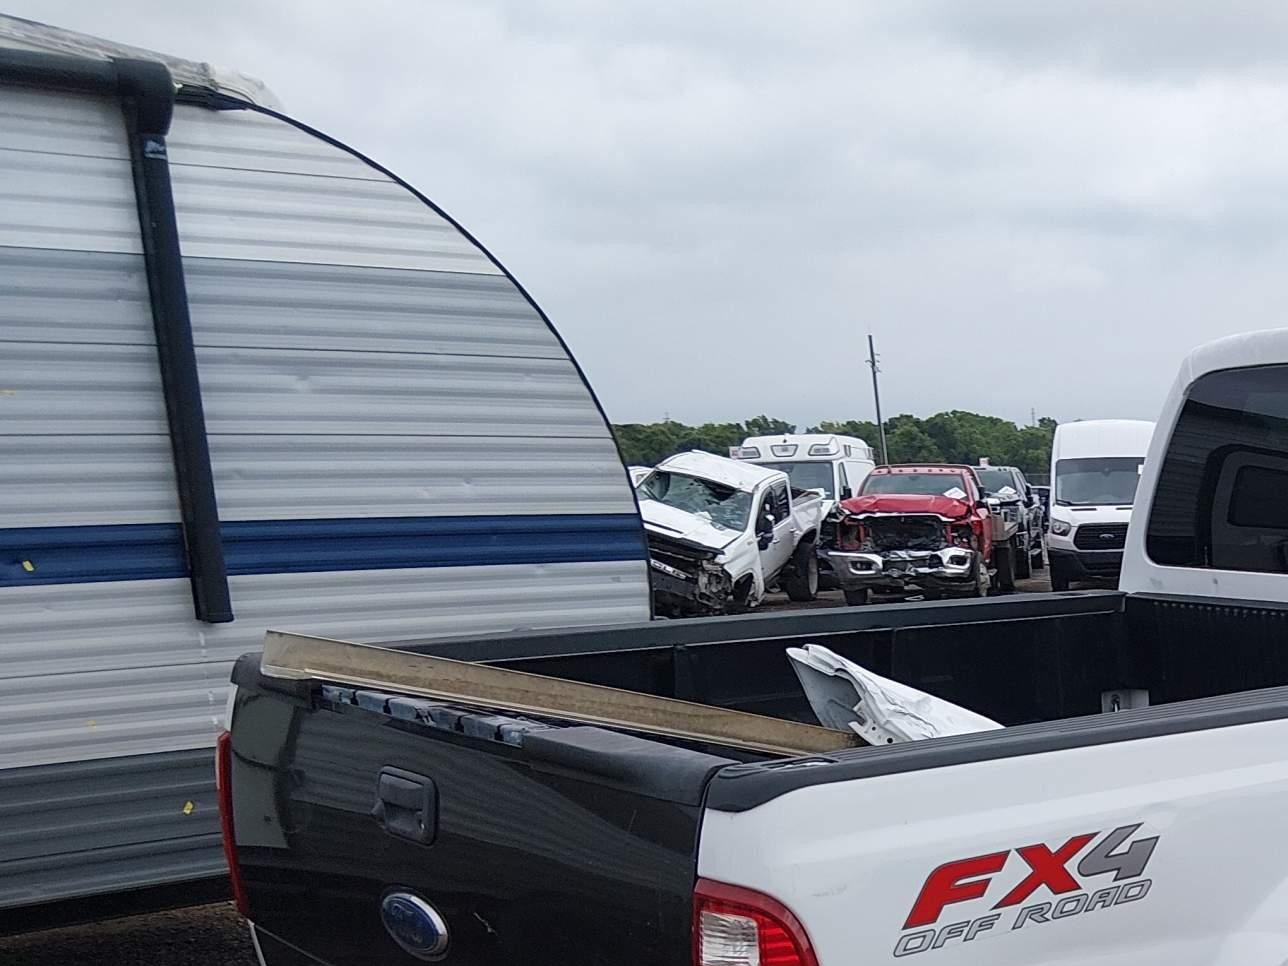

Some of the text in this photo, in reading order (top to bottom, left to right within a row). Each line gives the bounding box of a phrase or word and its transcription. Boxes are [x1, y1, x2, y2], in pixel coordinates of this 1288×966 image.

[893, 879, 1153, 958] OFF ROAD
[901, 822, 1160, 931] FX4
